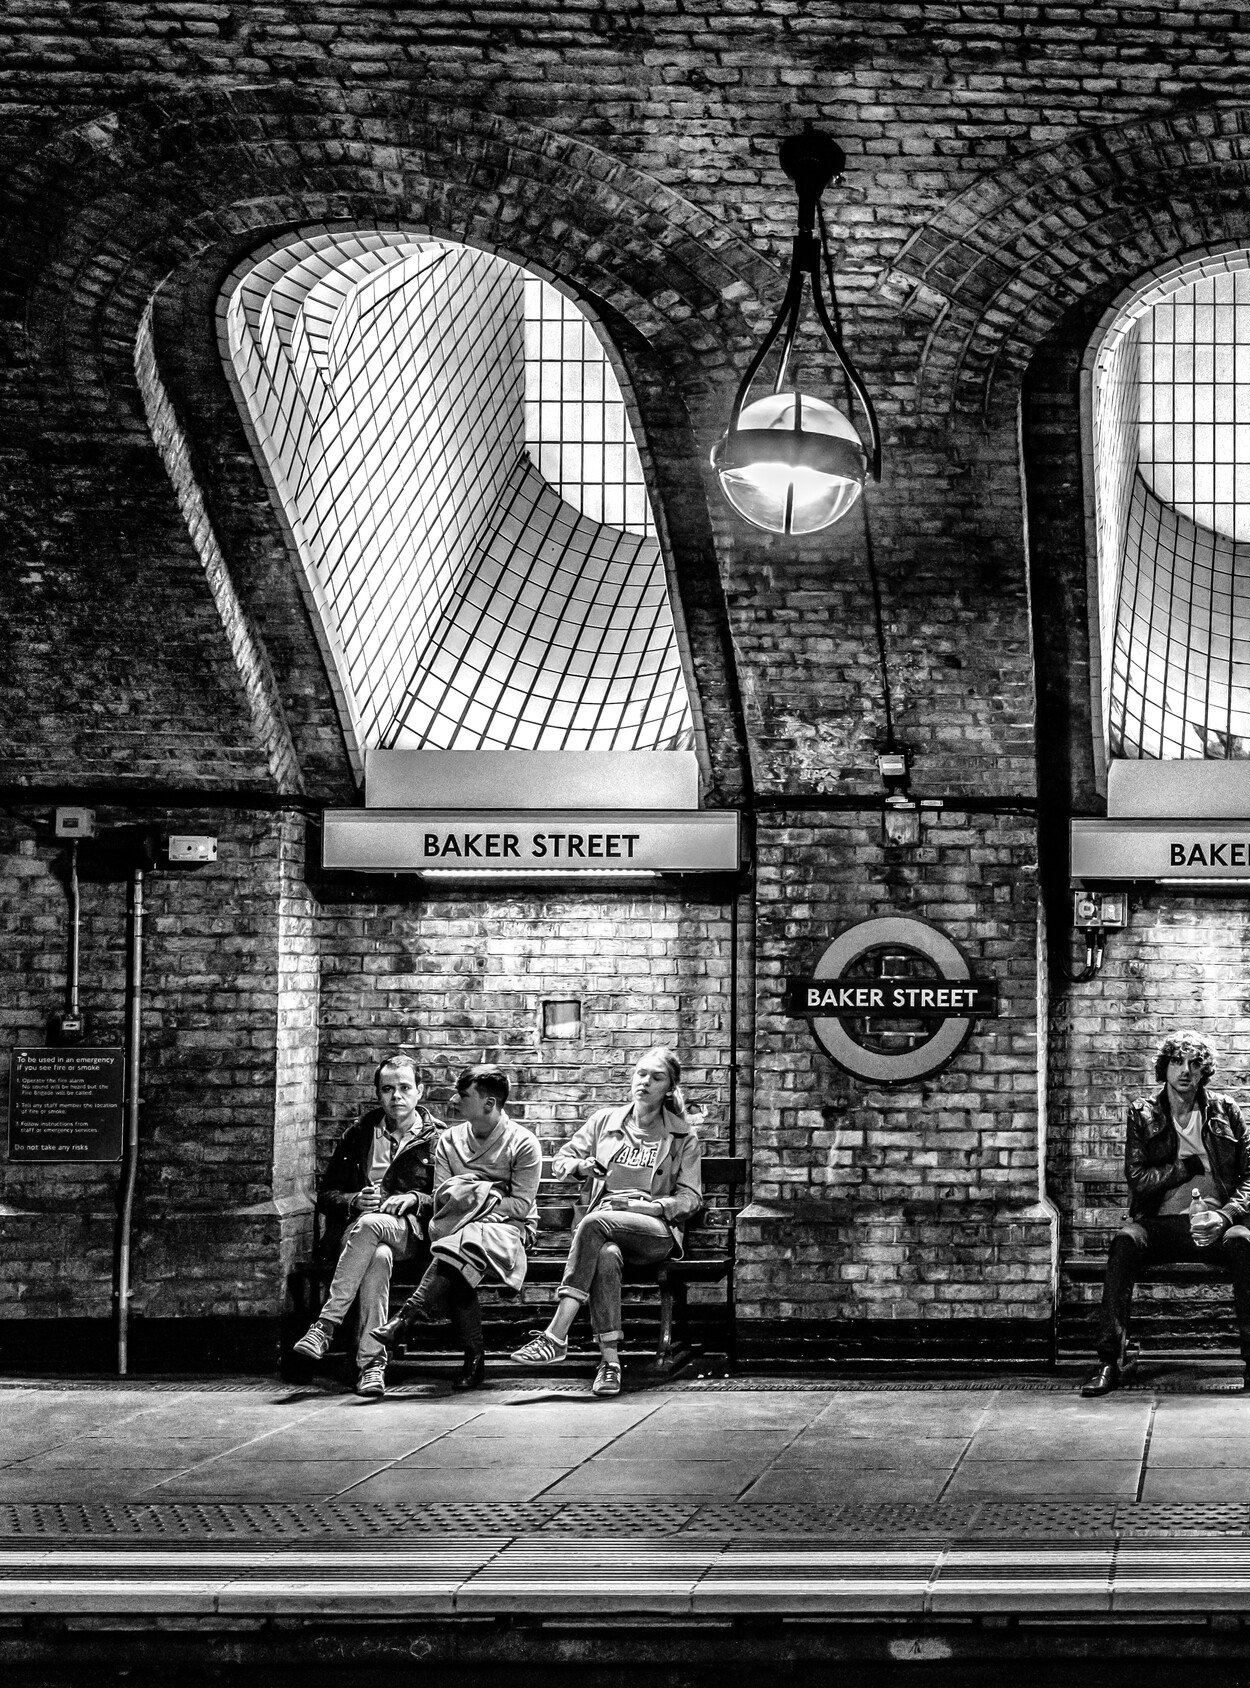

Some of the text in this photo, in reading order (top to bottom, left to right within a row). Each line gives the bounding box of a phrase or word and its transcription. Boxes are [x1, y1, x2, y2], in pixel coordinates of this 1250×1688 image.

[424, 833, 640, 857] BAKER STREET
[807, 988, 978, 1008] BAKER STREET
